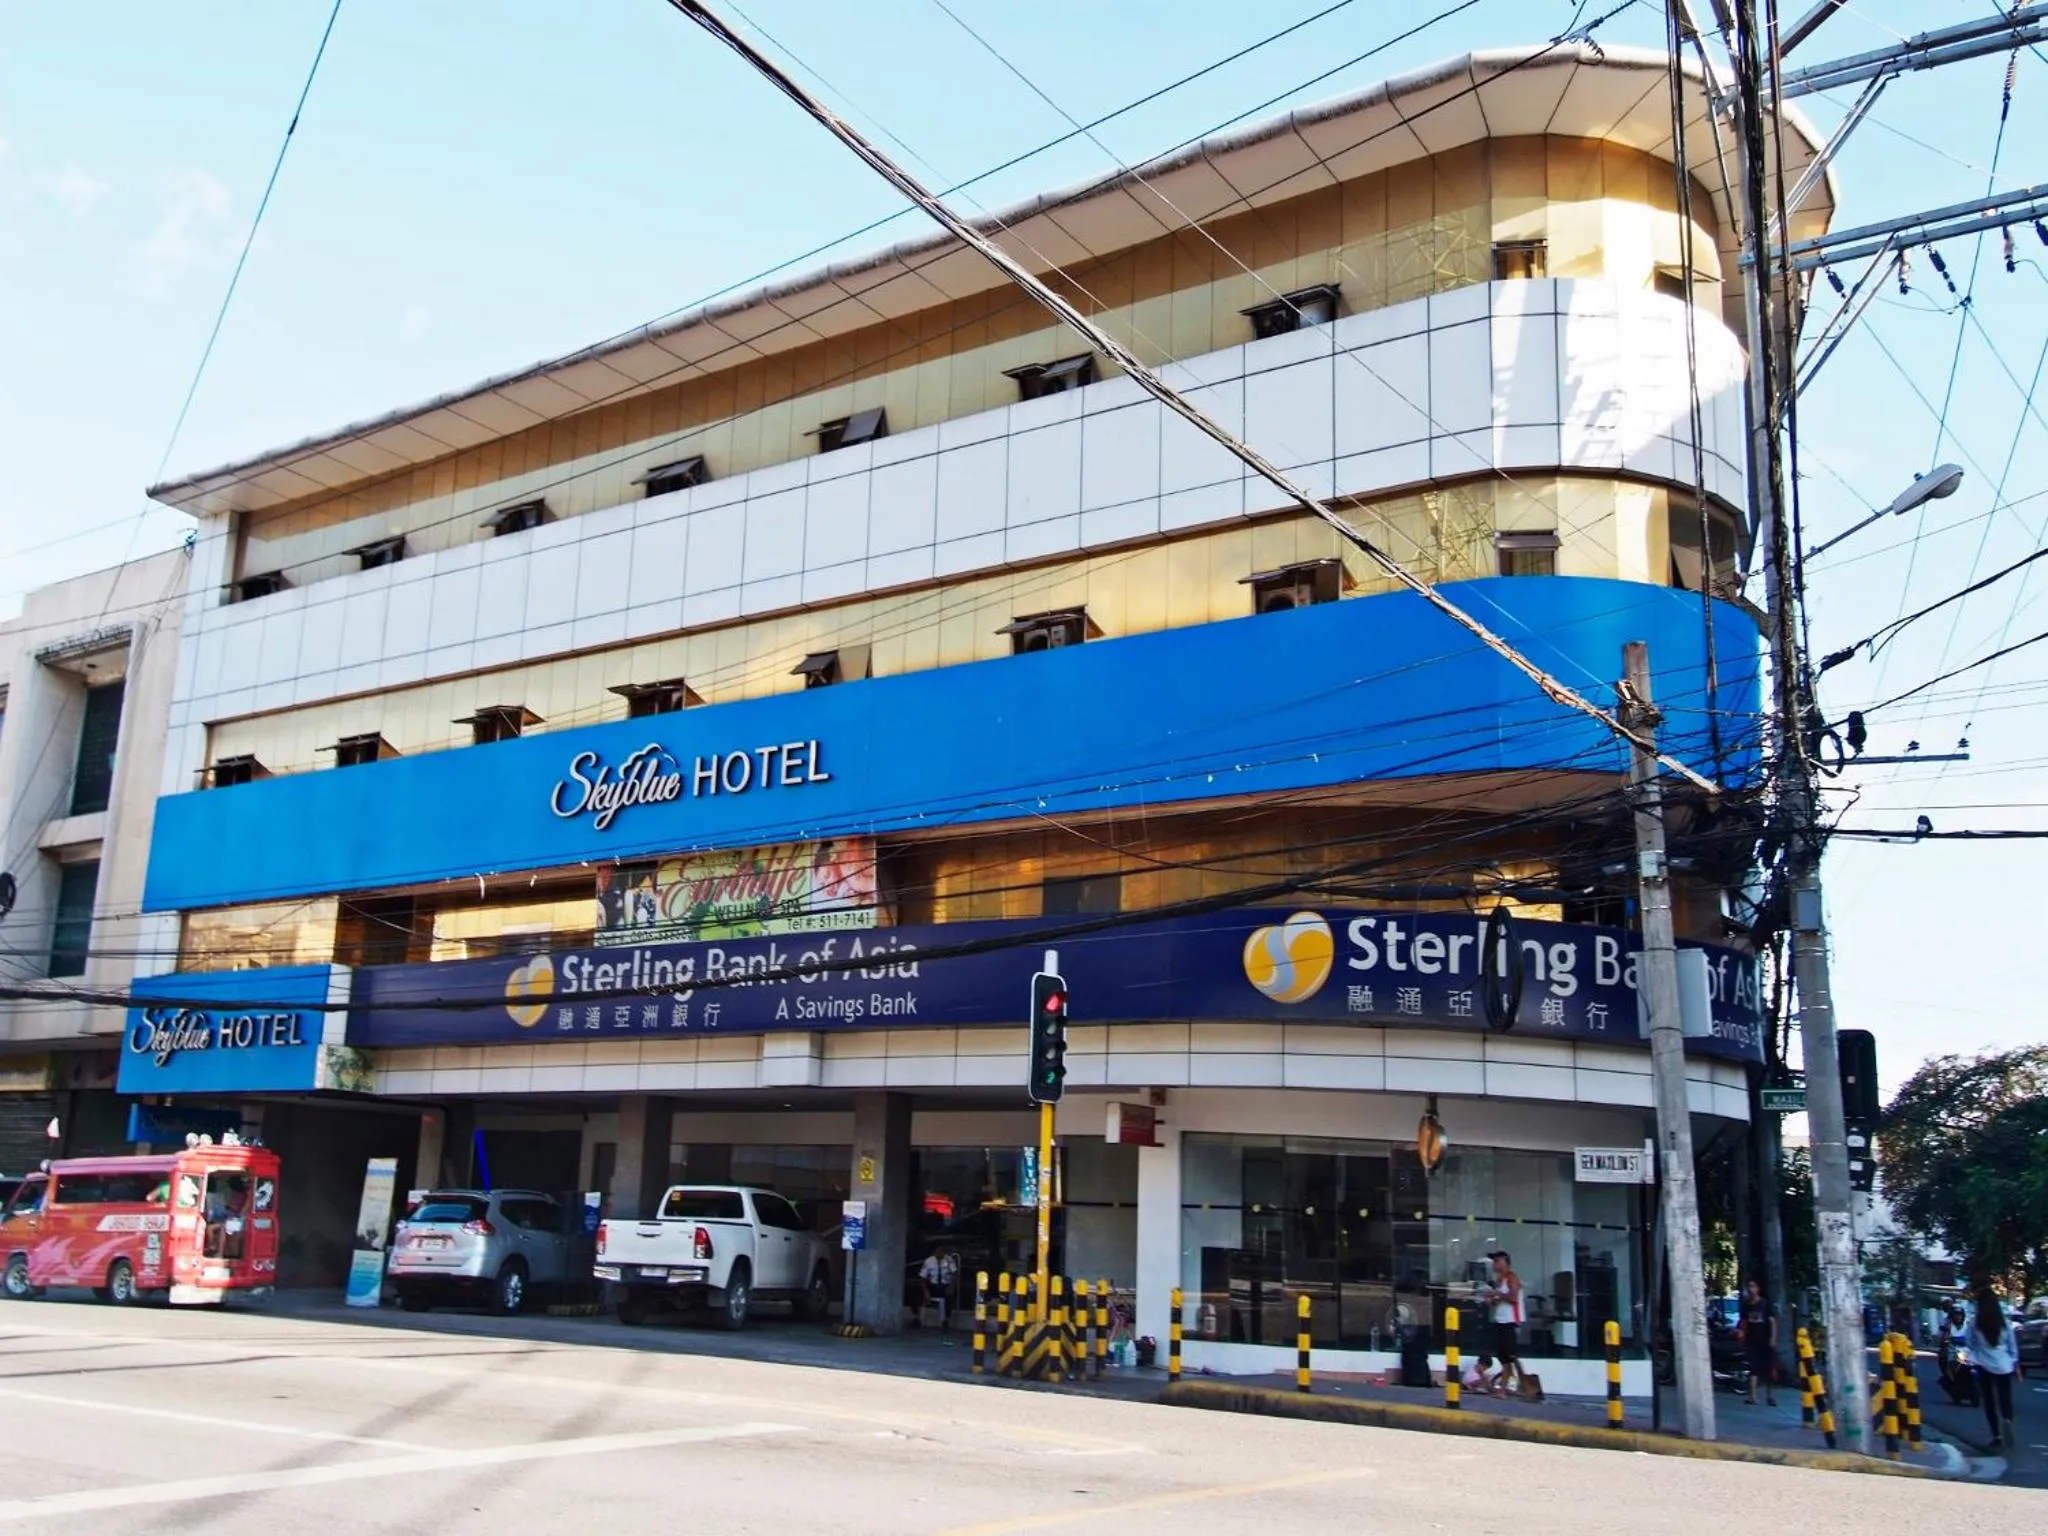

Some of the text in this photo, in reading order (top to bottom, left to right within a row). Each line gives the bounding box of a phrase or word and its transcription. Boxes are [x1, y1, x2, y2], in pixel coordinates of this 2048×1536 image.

[551, 739, 829, 830] Skyblue HOTEL
[787, 918, 802, 930] Tel
[820, 912, 869, 928] 511-7141
[562, 936, 920, 1001] Sterling Bank of Asia
[1347, 917, 1579, 997] Sterling
[776, 990, 918, 1023] A Savings Bank
[1347, 985, 1609, 1030] 融通亞銀行
[130, 1008, 303, 1067] Skyblue HOTEL
[1712, 1018, 1750, 1048] avings
